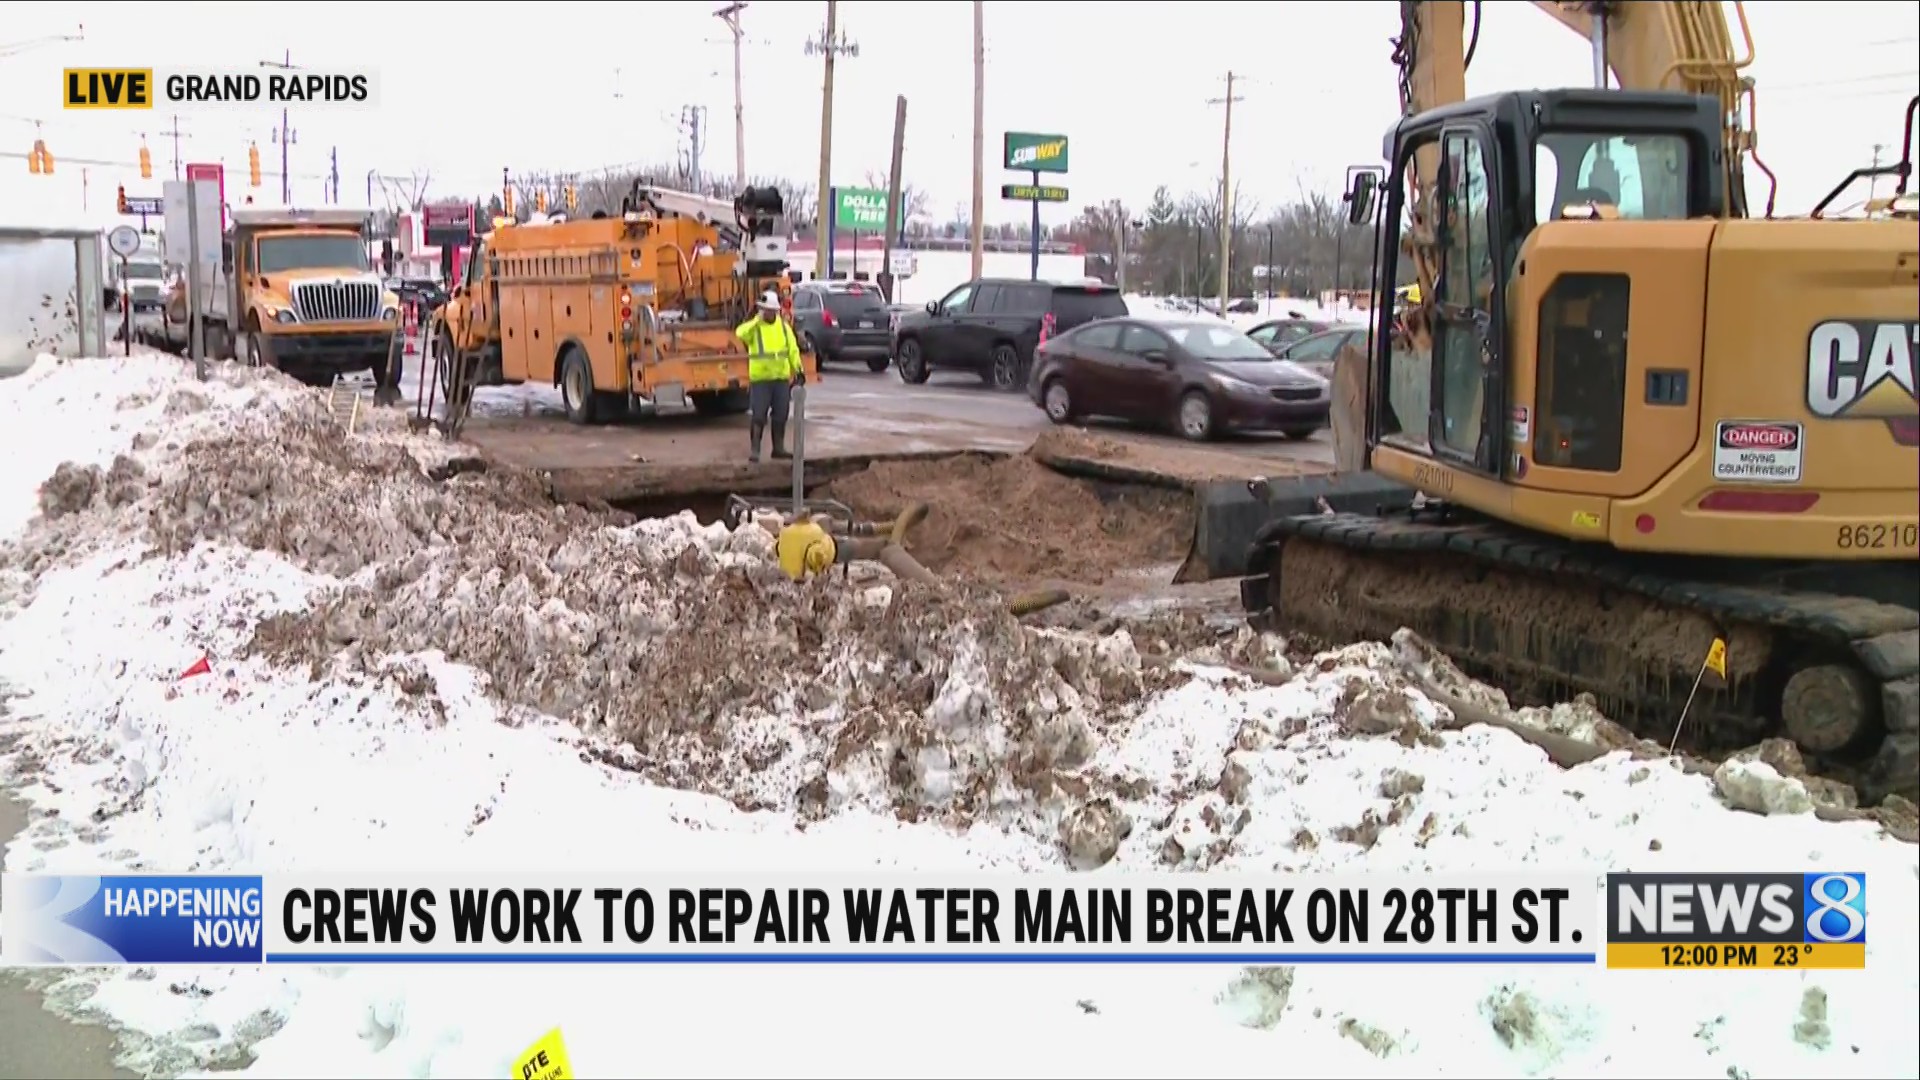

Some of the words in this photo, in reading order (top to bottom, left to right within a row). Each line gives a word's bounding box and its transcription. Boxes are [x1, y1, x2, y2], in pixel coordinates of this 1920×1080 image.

[1011, 139, 1066, 165] SUBWAY
[843, 195, 887, 208] DOLLA
[1808, 322, 1918, 415] CA
[1728, 429, 1789, 444] DANGER
[1740, 453, 1775, 463] MOVING
[1718, 463, 1796, 476] COUNTERWEIGHT
[523, 1050, 549, 1080] DTE
